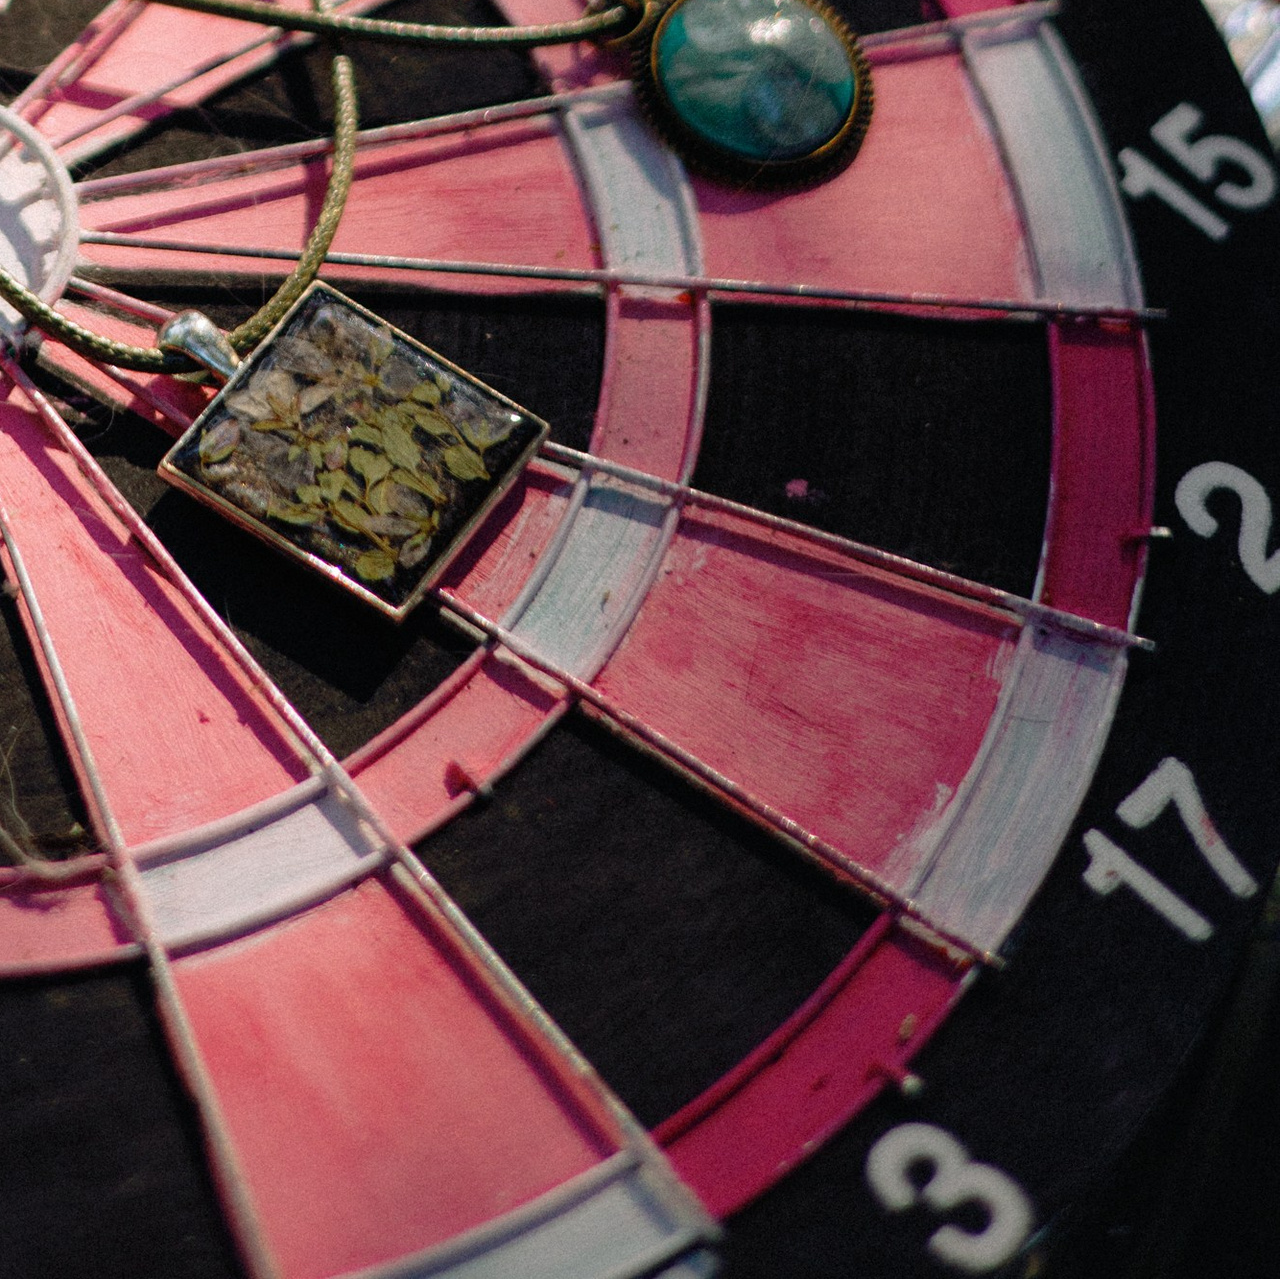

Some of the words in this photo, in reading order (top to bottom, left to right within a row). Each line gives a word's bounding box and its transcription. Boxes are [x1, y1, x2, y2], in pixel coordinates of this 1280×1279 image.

[1119, 102, 1277, 240] 15
[1174, 460, 1280, 595] 2
[1083, 757, 1259, 941] 17
[866, 1123, 1033, 1272] 3
